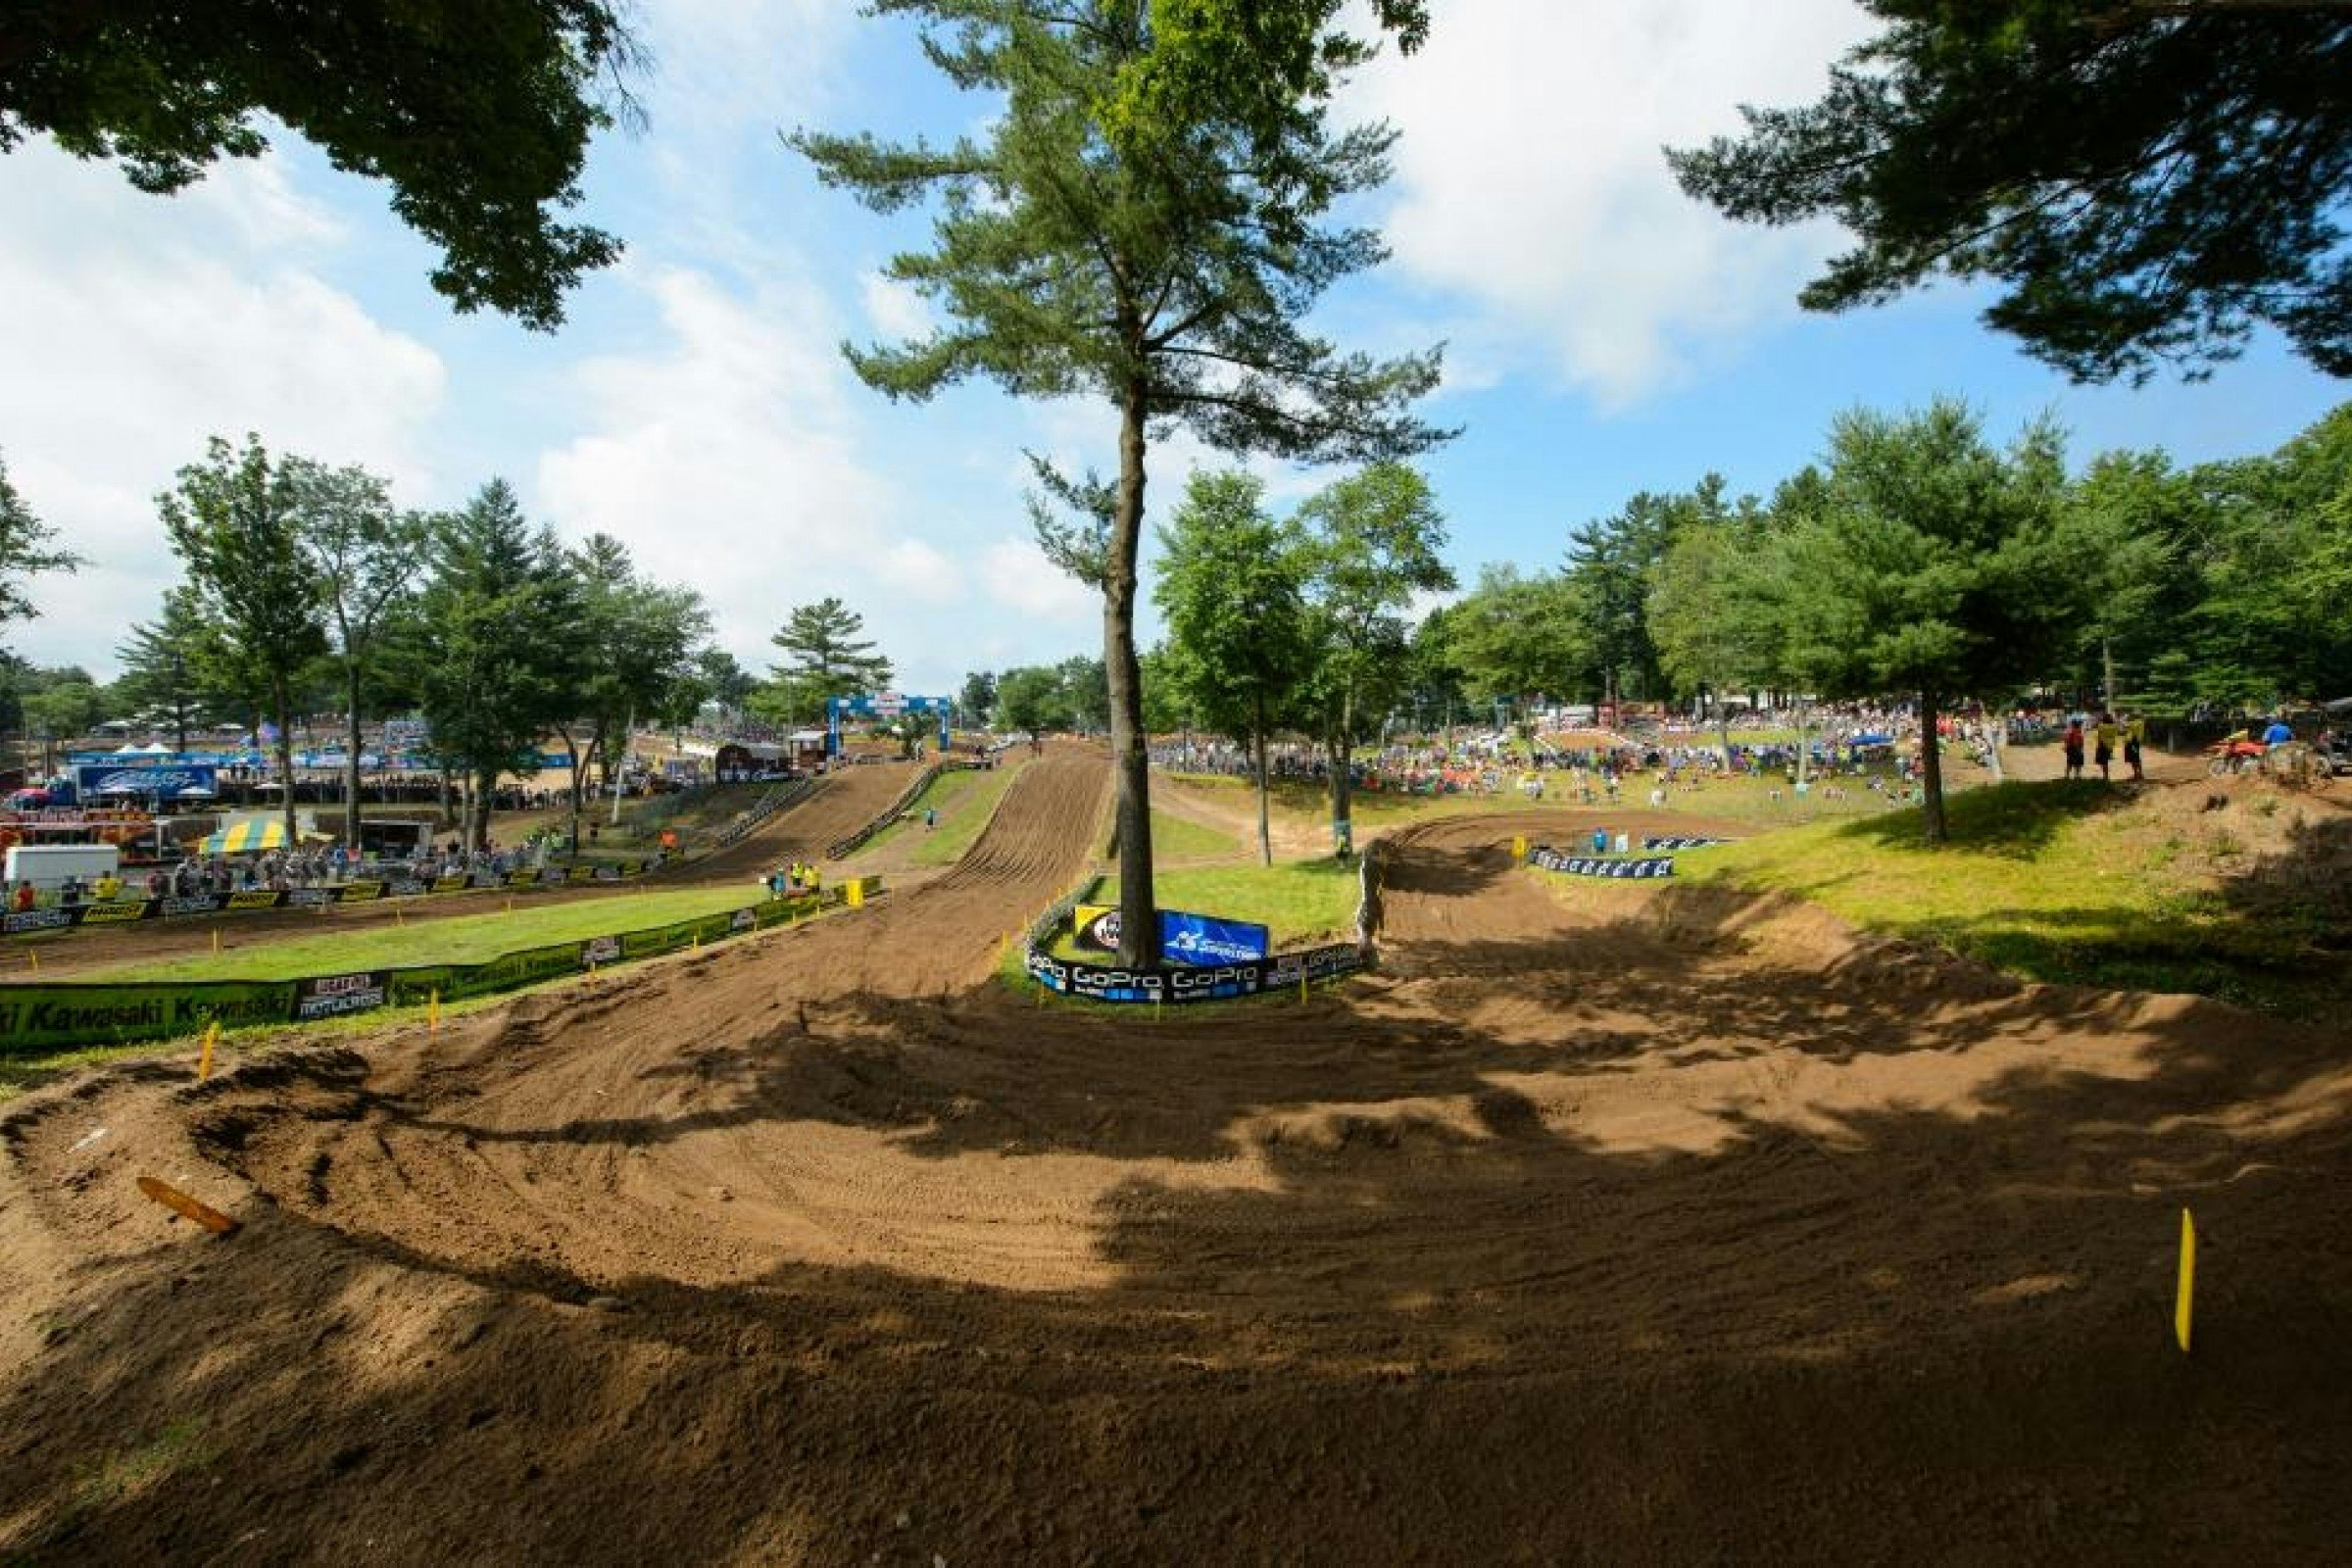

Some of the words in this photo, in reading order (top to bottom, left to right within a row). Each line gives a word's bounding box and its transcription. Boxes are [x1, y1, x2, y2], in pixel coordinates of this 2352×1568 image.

[1073, 966, 1162, 988] GoPro
[1172, 967, 1257, 988] GoPro
[29, 999, 164, 1030] Kawasaki
